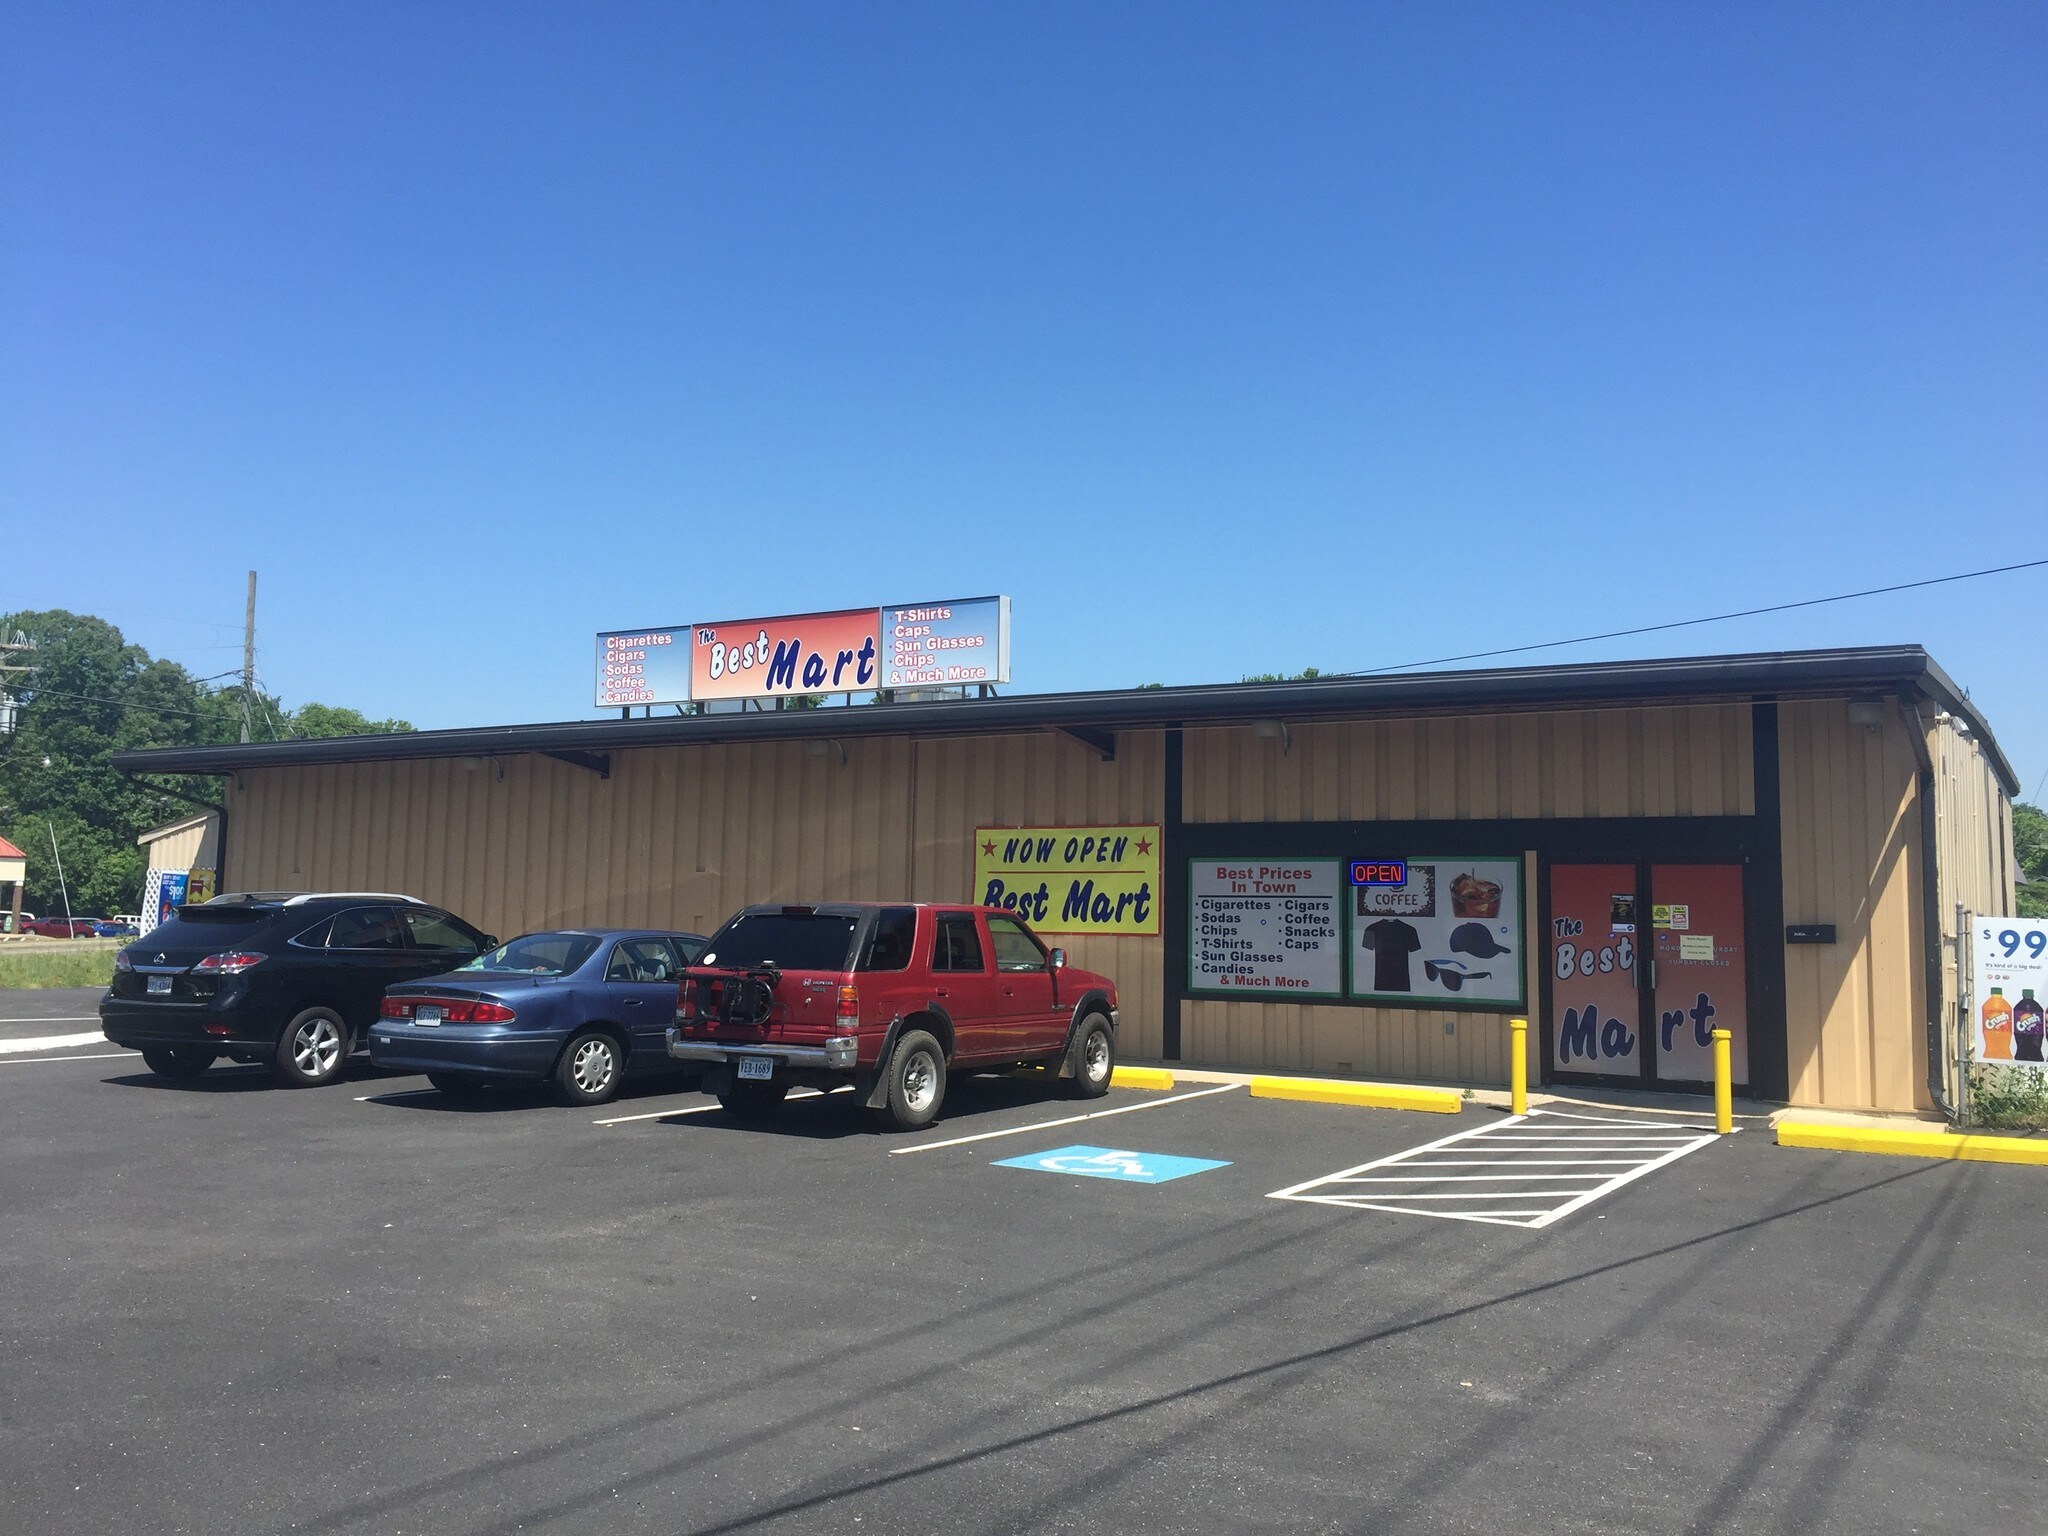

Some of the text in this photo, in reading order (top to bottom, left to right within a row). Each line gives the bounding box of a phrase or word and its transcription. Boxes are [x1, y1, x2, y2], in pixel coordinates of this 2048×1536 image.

[895, 607, 951, 623] T-Shirts
[698, 628, 716, 646] The
[894, 625, 931, 639] Caps
[606, 634, 672, 650] Cigarettes
[894, 635, 984, 653] Sun Glasses
[606, 650, 646, 663] Cigars
[709, 629, 769, 680] Best
[894, 654, 935, 668] Chips
[606, 664, 643, 676] Sodas
[765, 636, 876, 691] Mart
[890, 666, 986, 684] & Much More
[606, 677, 645, 689] Coffee
[605, 689, 654, 703] Candies
[1003, 836, 1128, 863] NOW OPEN
[1217, 867, 1313, 880] Best Prices
[1355, 866, 1402, 882] OPEN
[1231, 880, 1296, 893] In Town
[983, 879, 1151, 924] Best Mart
[1201, 899, 1271, 912] Cigarettes
[1284, 900, 1330, 913] Cigars
[1375, 894, 1419, 906] COFFEE
[1201, 912, 1241, 924] Sodas
[1284, 913, 1330, 925] Coffee
[1201, 925, 1238, 937] Chips
[1284, 926, 1335, 938] Snacks
[1554, 917, 1583, 938] The
[1201, 938, 1253, 950] T-Shirts
[1284, 939, 1319, 952] Caps
[1201, 951, 1284, 963] Sun Glasses
[1556, 935, 1634, 980] Best
[1201, 963, 1254, 975] Candies
[1220, 975, 1310, 988] & Much More
[1985, 1012, 2009, 1030] Crush
[2016, 1013, 2040, 1031] Crush
